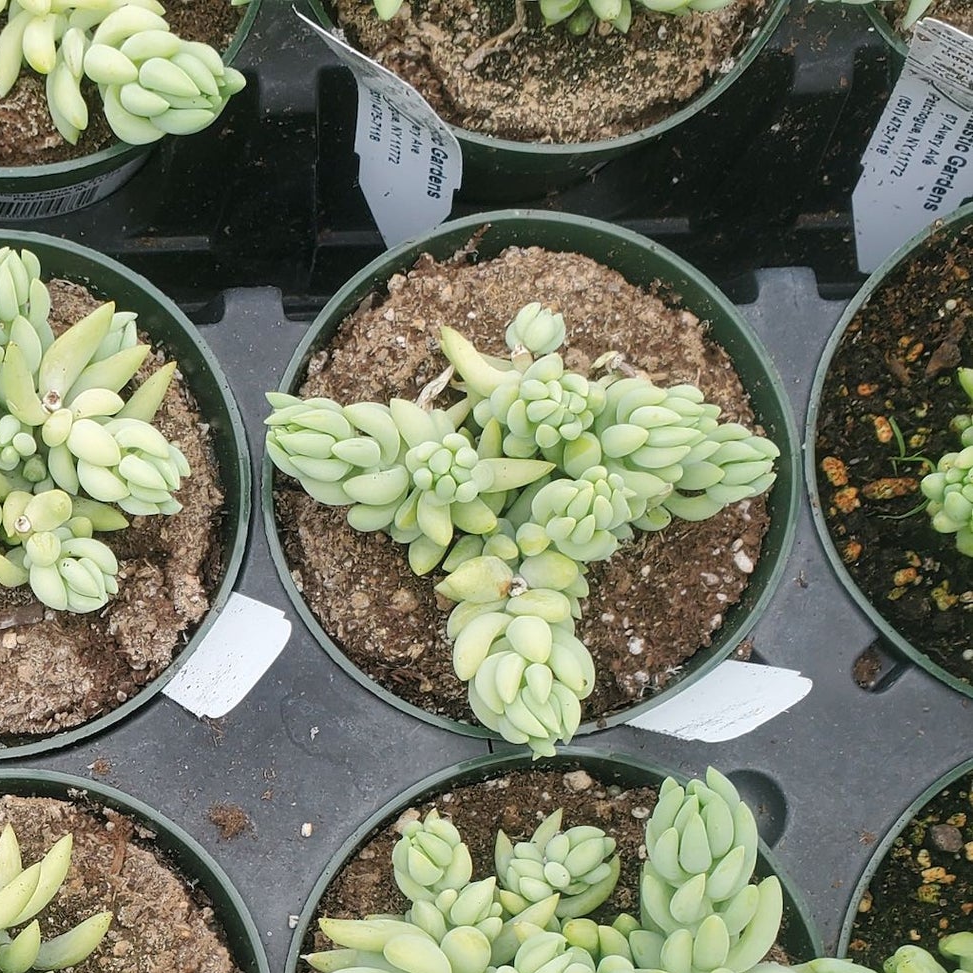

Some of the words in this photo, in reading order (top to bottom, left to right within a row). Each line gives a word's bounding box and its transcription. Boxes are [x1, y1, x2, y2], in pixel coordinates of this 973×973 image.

[391, 124, 402, 140] NY
[876, 116, 903, 155] 475-7118
[902, 136, 920, 152] NY
[928, 123, 953, 149] Avery
[388, 139, 401, 165] 11772
[890, 152, 913, 177] 11772
[921, 147, 940, 166] Ave
[427, 147, 448, 199] Gardens
[923, 155, 968, 212] Gardens
